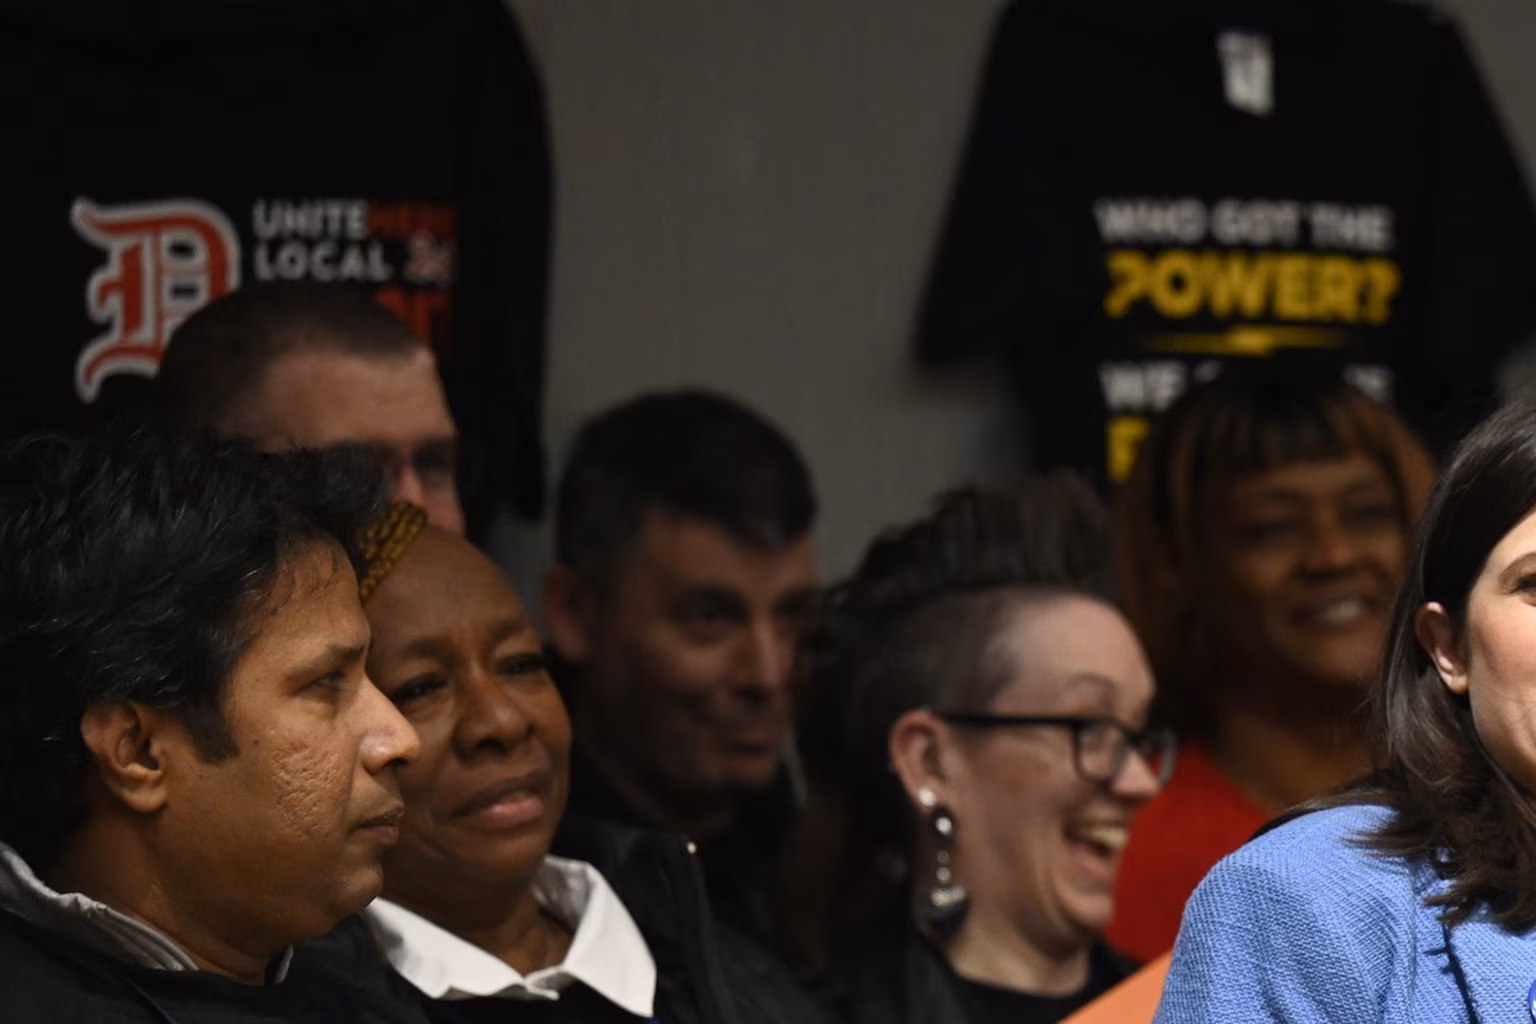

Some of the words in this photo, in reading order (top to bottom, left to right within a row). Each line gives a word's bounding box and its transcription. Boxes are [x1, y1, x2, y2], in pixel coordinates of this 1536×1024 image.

[1095, 199, 1205, 243] WHO
[1212, 199, 1300, 244] GOT
[1308, 205, 1395, 252] THE
[253, 242, 392, 282] LOCAL
[1104, 250, 1402, 322] POWER?
